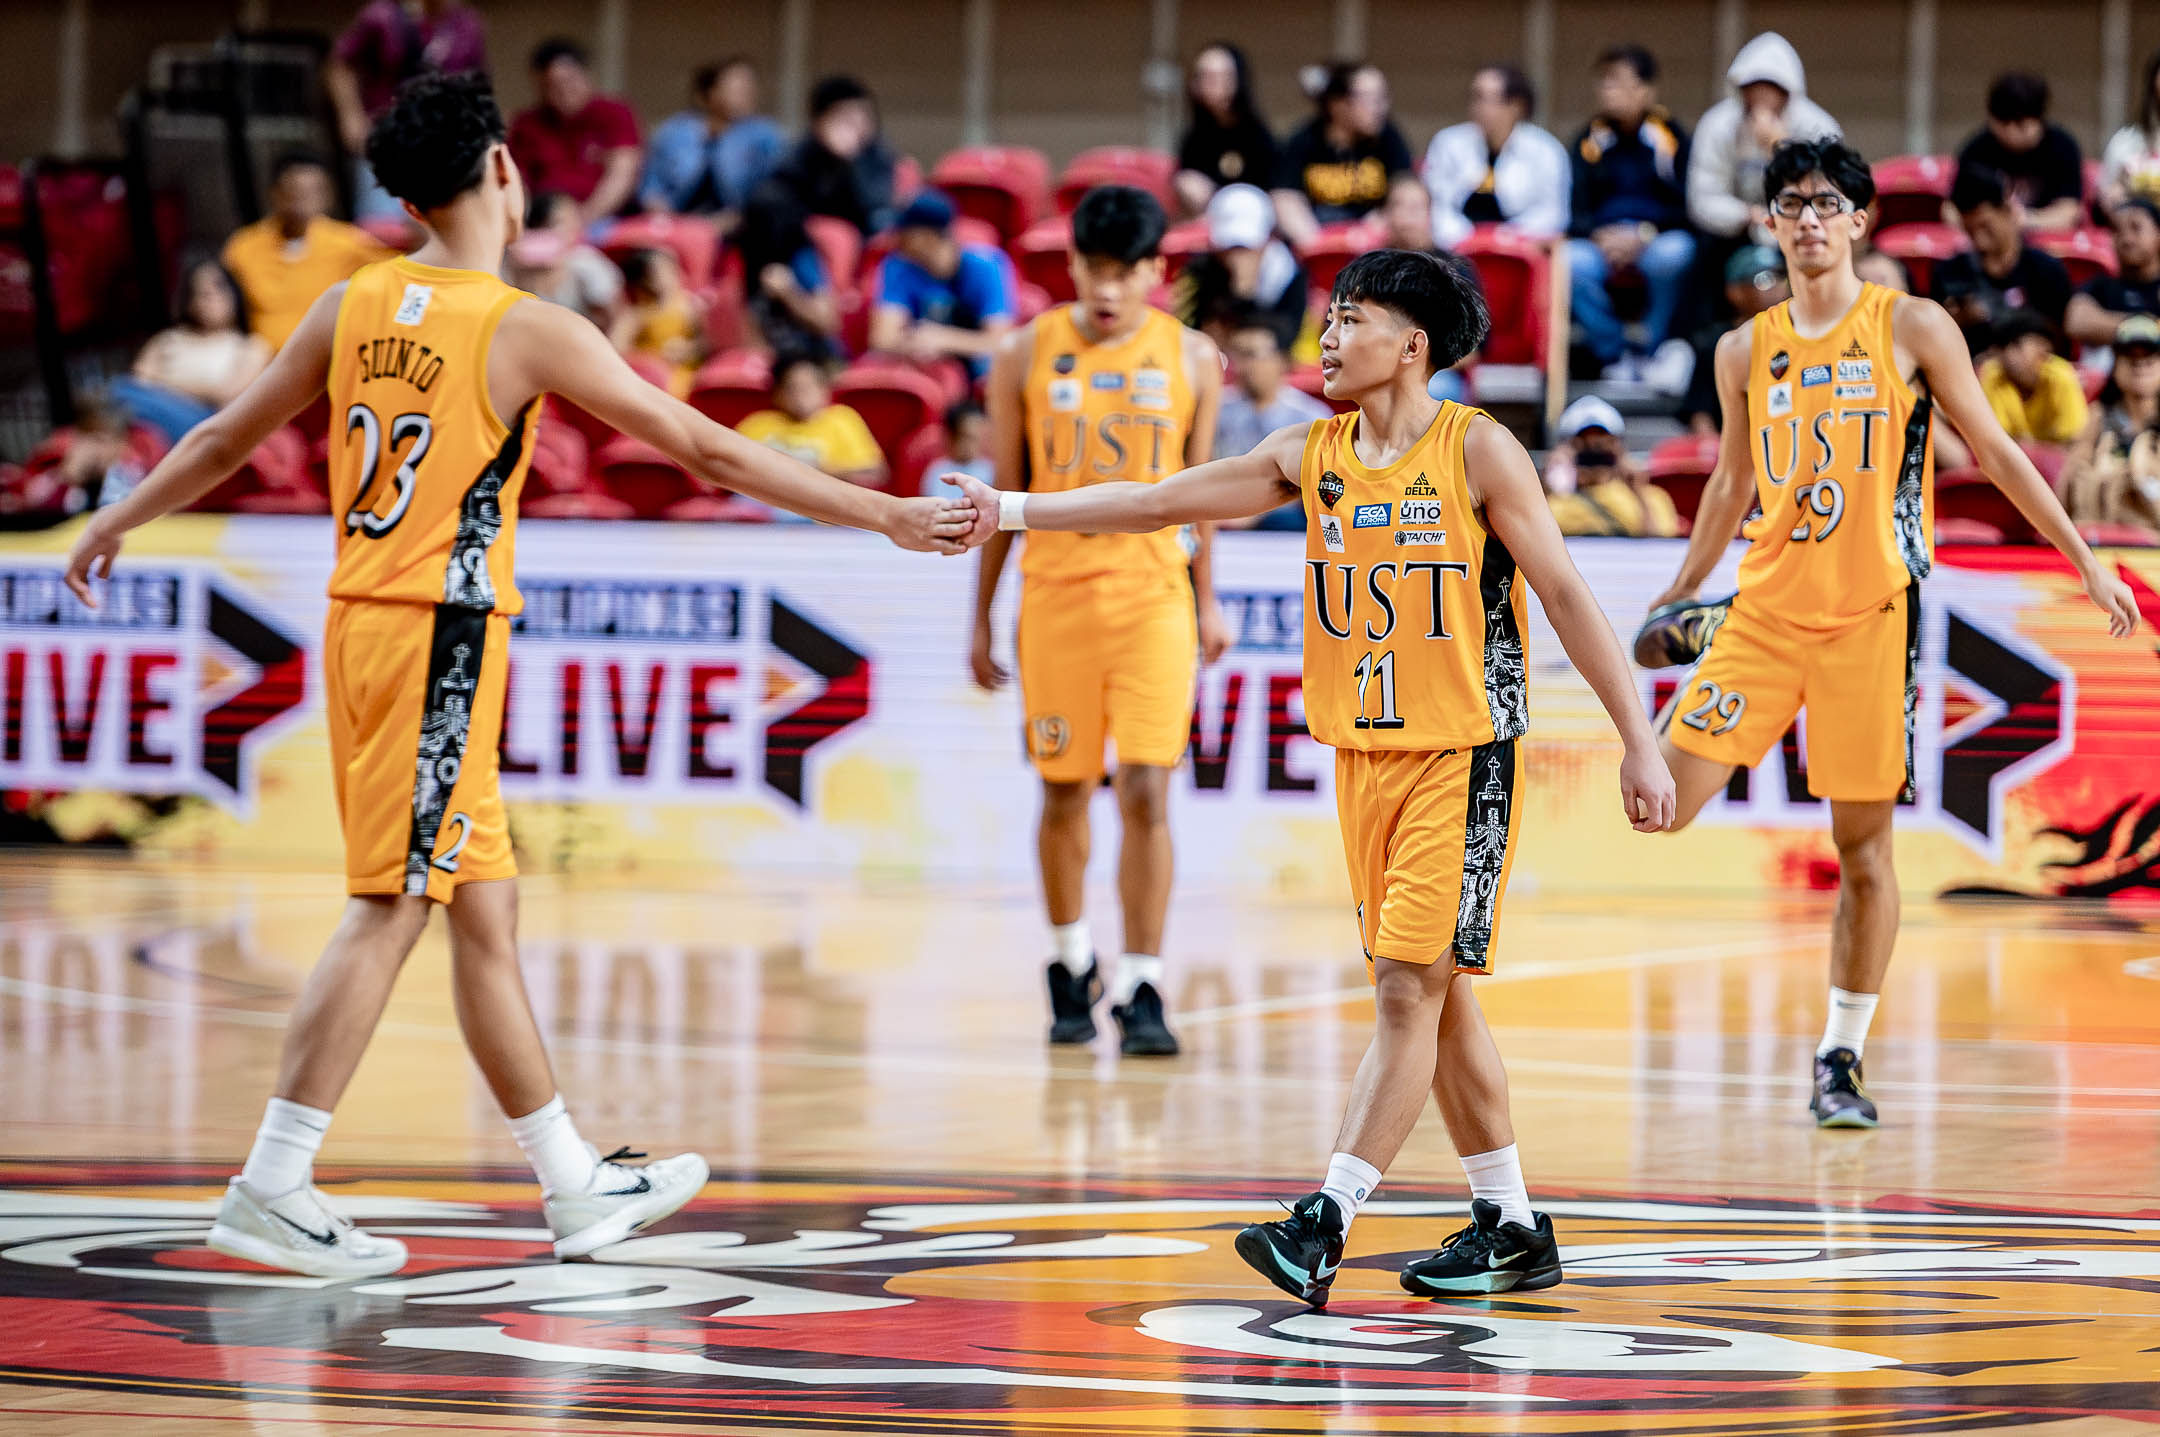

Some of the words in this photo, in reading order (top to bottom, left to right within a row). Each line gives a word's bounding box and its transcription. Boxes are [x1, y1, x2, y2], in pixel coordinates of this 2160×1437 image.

[345, 402, 432, 539] 23
[1044, 413, 1175, 474] UST
[1760, 408, 1889, 485] UST
[1405, 486, 1438, 496] DELTA
[1791, 477, 1845, 542] 29
[1306, 560, 1470, 642] UST
[3, 648, 178, 763] IVE
[1354, 650, 1405, 729] 11
[1682, 680, 1747, 736] 29
